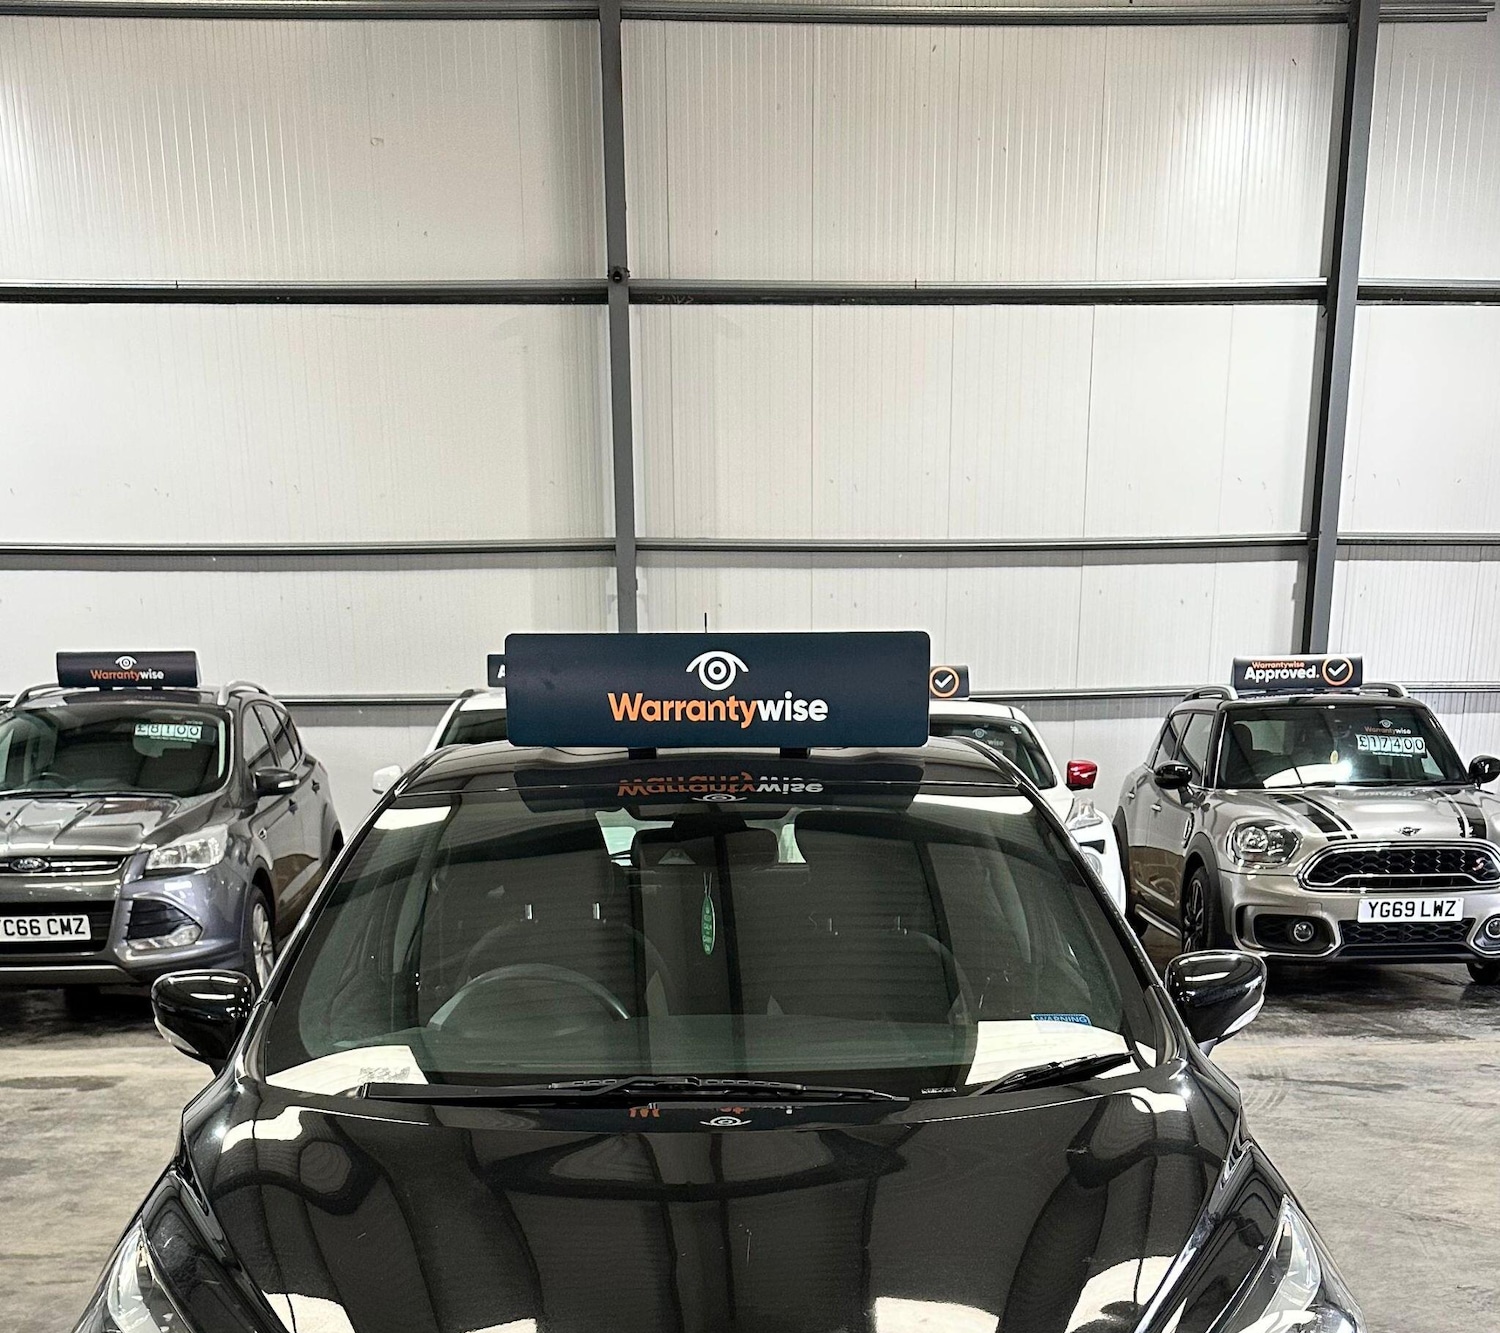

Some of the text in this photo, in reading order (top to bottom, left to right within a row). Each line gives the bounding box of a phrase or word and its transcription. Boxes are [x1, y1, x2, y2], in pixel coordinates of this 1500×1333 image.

[1251, 660, 1305, 670] Warrantywise
[90, 668, 165, 681] Warrantywise
[1244, 665, 1320, 683] Approved.
[607, 690, 829, 729] Warrantywise
[1364, 726, 1412, 735] Warrantywise
[1359, 736, 1424, 751] £17400
[1368, 900, 1456, 918] YG69 LWZ
[0, 917, 86, 936] C66 CMZ
